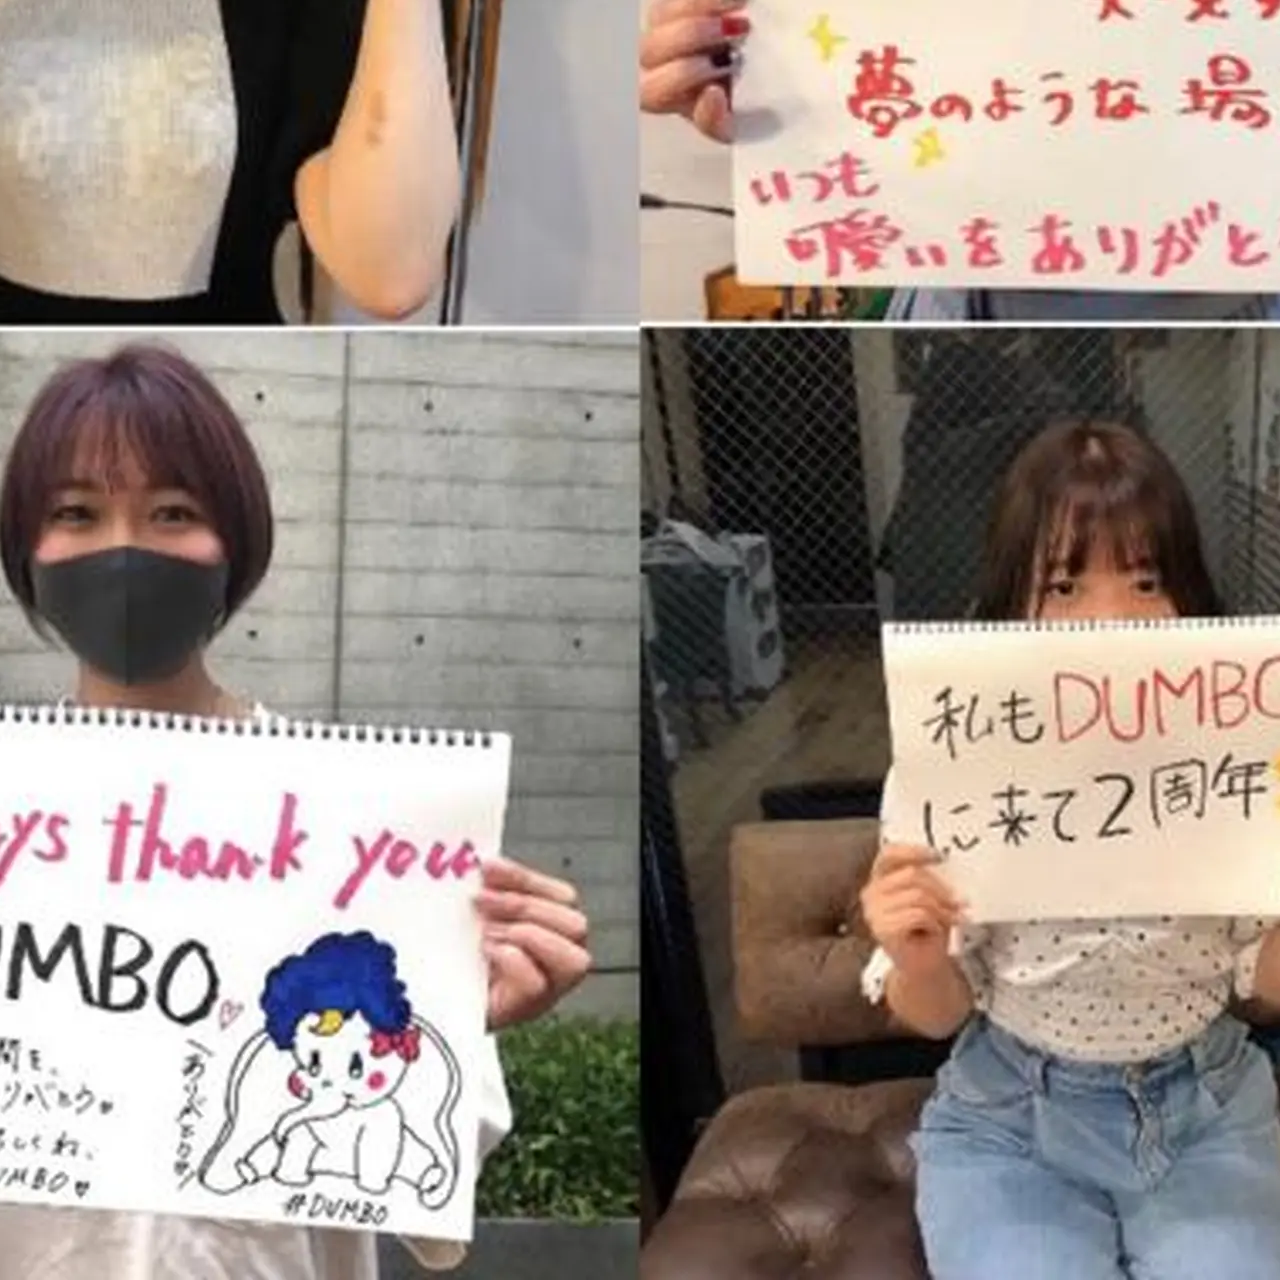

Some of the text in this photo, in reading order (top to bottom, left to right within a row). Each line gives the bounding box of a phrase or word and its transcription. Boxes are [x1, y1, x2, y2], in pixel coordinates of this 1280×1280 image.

[750, 151, 882, 206] いつも
[103, 782, 310, 884] thank
[351, 829, 483, 910] you
[923, 753, 1270, 859] に来て2周年
[281, 1192, 389, 1225] #DUMBO
